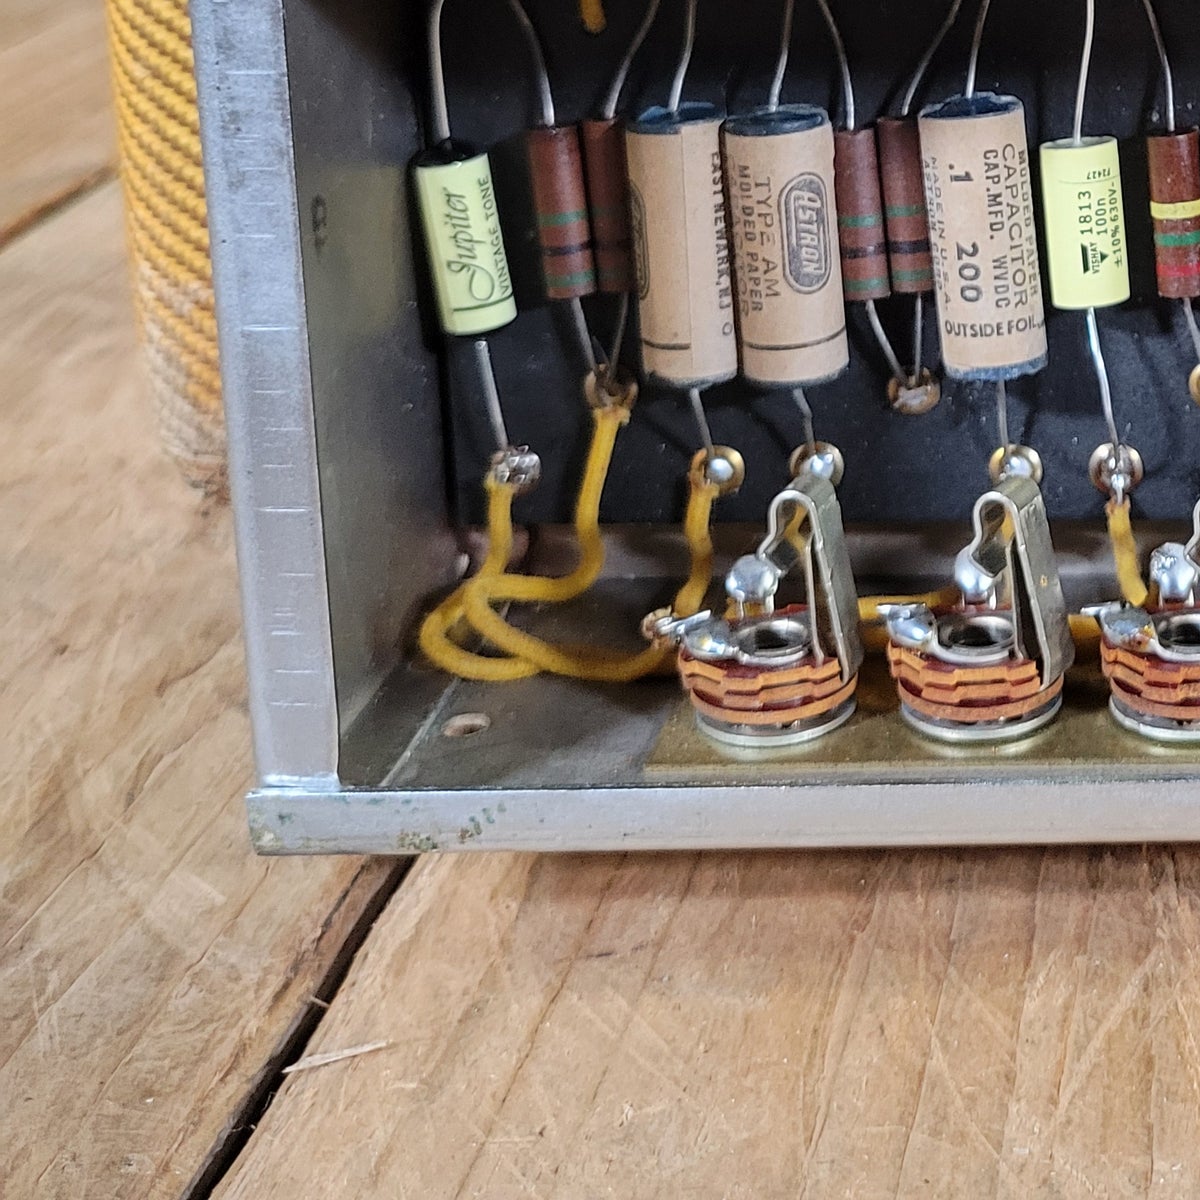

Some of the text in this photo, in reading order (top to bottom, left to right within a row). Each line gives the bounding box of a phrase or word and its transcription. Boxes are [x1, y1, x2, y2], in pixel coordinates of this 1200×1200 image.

[931, 156, 944, 213] MADE
[1002, 143, 1028, 308] CAPACITOR
[1018, 150, 1039, 296] MOLDED PAPER
[1078, 190, 1093, 235] 1813
[1095, 197, 1108, 236] 100n
[442, 187, 495, 301] Jupiter
[478, 175, 512, 295] VINTAGE TONE
[738, 164, 763, 312] MOLDED PAPER
[754, 176, 781, 298] TYPE AM
[792, 190, 825, 274] ASTRON
[937, 220, 945, 240] IN
[948, 163, 983, 303] .1 200
[1089, 241, 1100, 274] VISHAY
[992, 255, 1010, 308] WVDC
[945, 314, 1037, 338] OUTSIDE FOIL
